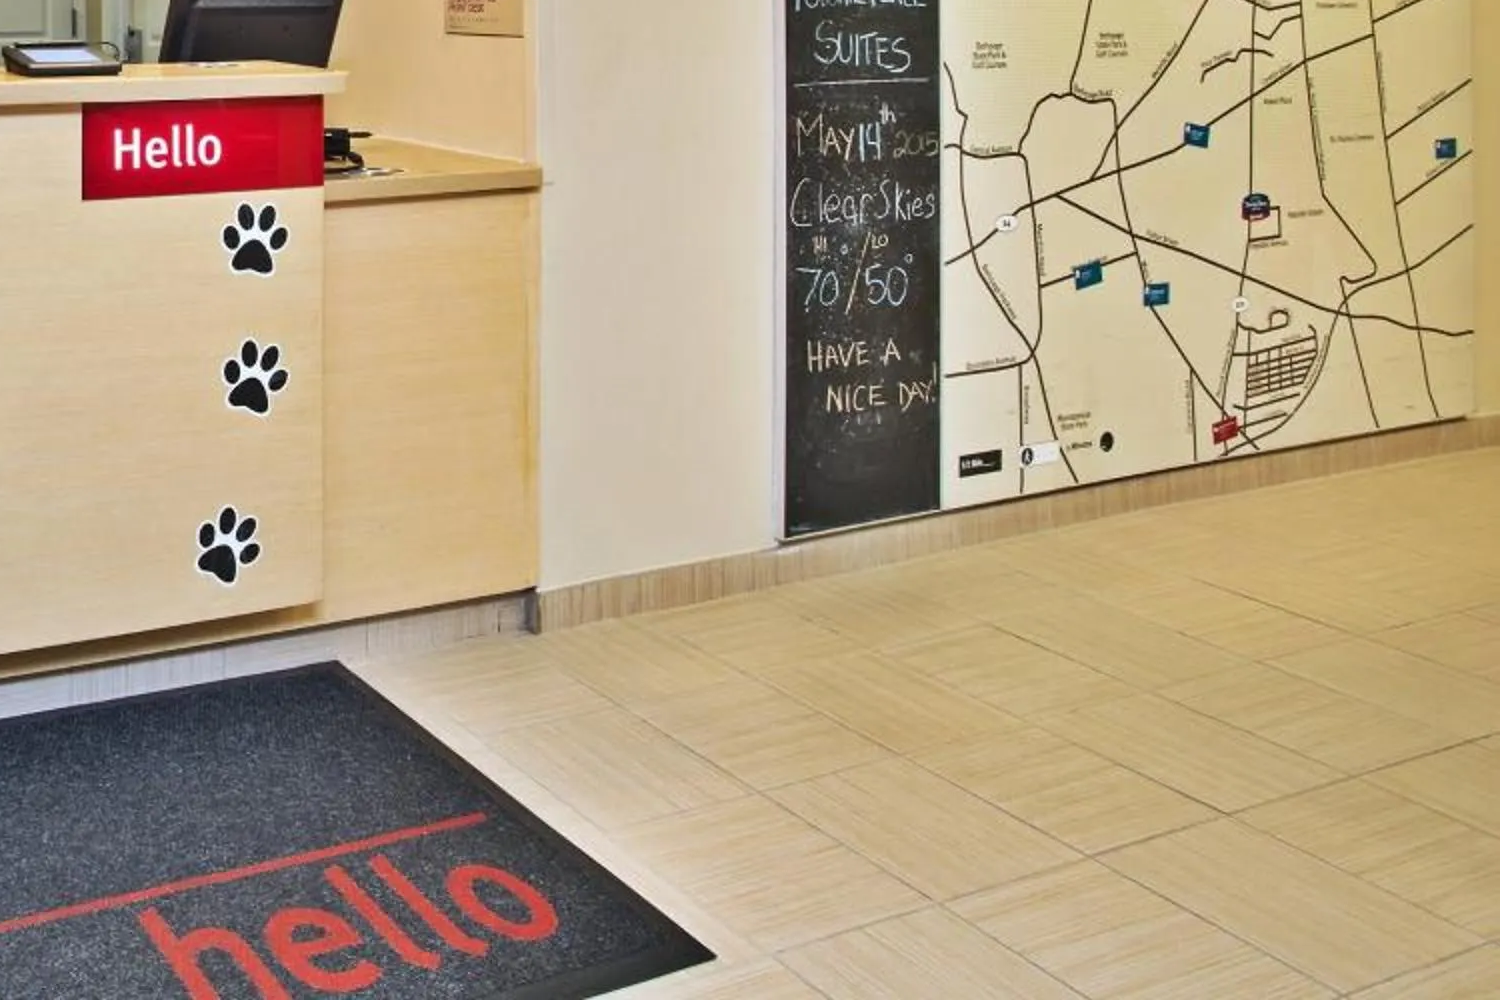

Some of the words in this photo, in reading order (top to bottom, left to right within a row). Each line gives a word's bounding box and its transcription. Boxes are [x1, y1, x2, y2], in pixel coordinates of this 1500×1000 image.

[813, 20, 911, 73] SUITES
[113, 122, 223, 171] Hello
[873, 178, 935, 222] Skies
[807, 340, 869, 373] HAVE
[880, 337, 901, 366] A
[825, 384, 886, 413] NICE
[138, 854, 559, 1000] hello
